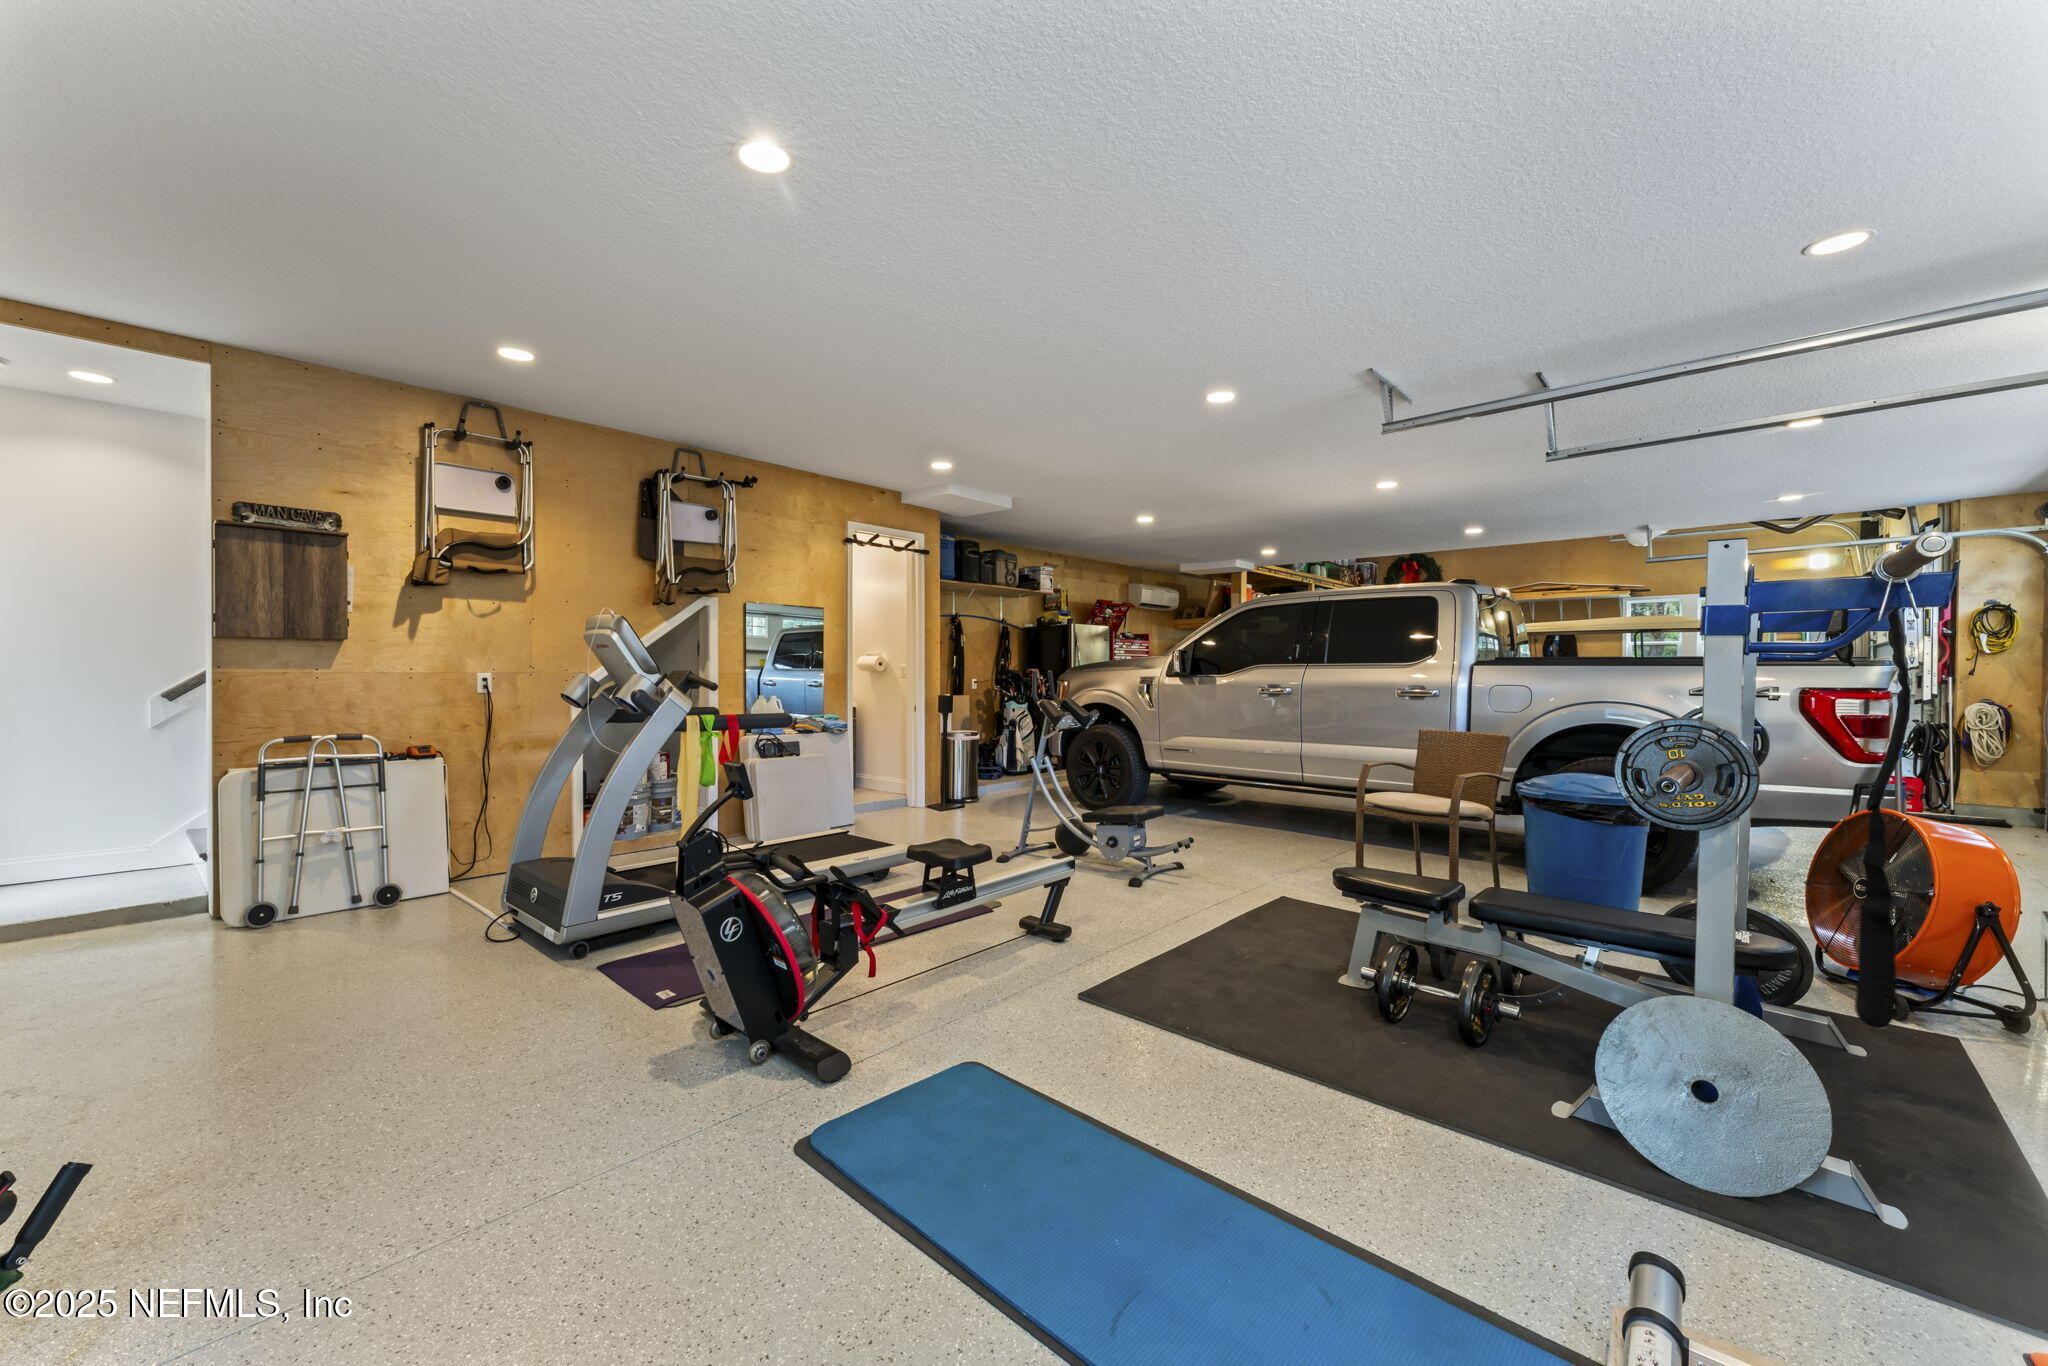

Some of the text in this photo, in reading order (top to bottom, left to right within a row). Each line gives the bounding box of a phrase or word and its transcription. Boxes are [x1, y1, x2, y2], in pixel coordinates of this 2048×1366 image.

[253, 503, 324, 523] MAN CAVE
[1667, 748, 1687, 760] 10
[1658, 800, 1718, 808] GOLD'S
